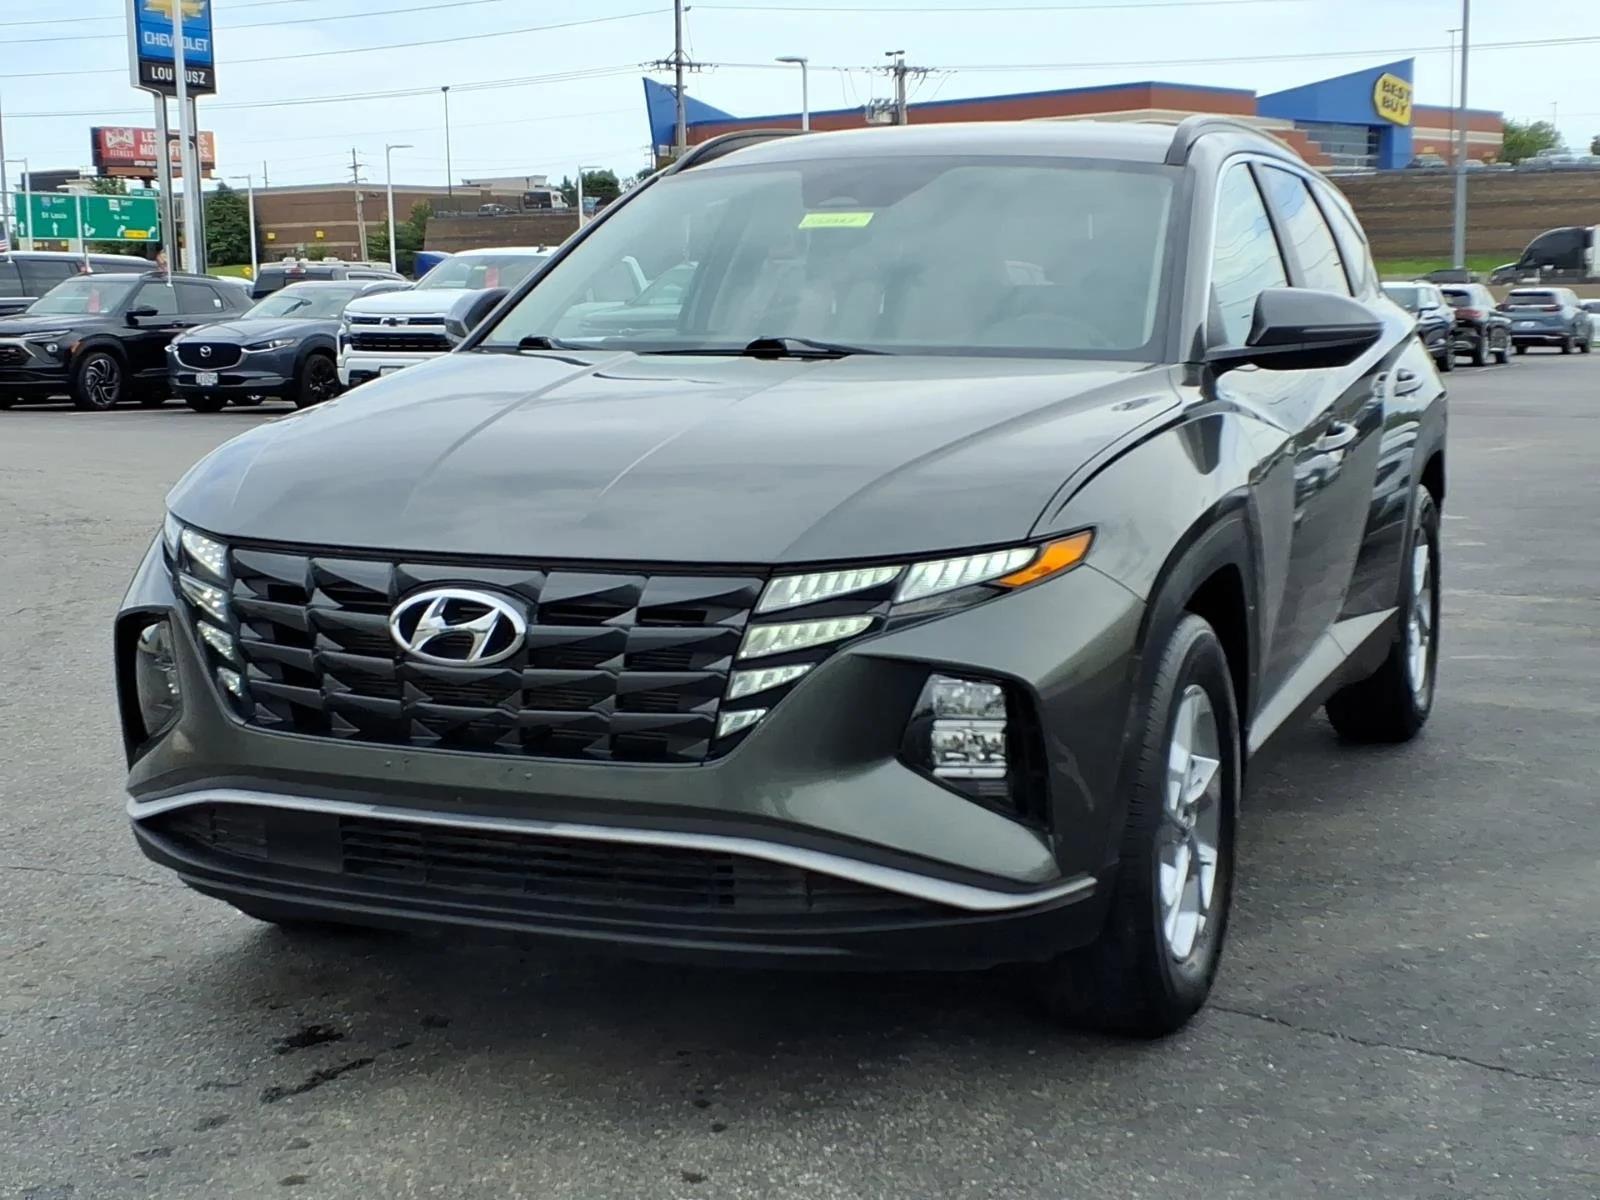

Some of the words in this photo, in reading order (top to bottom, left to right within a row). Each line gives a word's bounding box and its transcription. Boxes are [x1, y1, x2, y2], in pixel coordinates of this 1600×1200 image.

[144, 31, 209, 52] CHEVOLET
[151, 66, 173, 80] LOU
[183, 69, 206, 84] USZ
[1382, 80, 1411, 100] BEST
[1382, 95, 1409, 116] BUY
